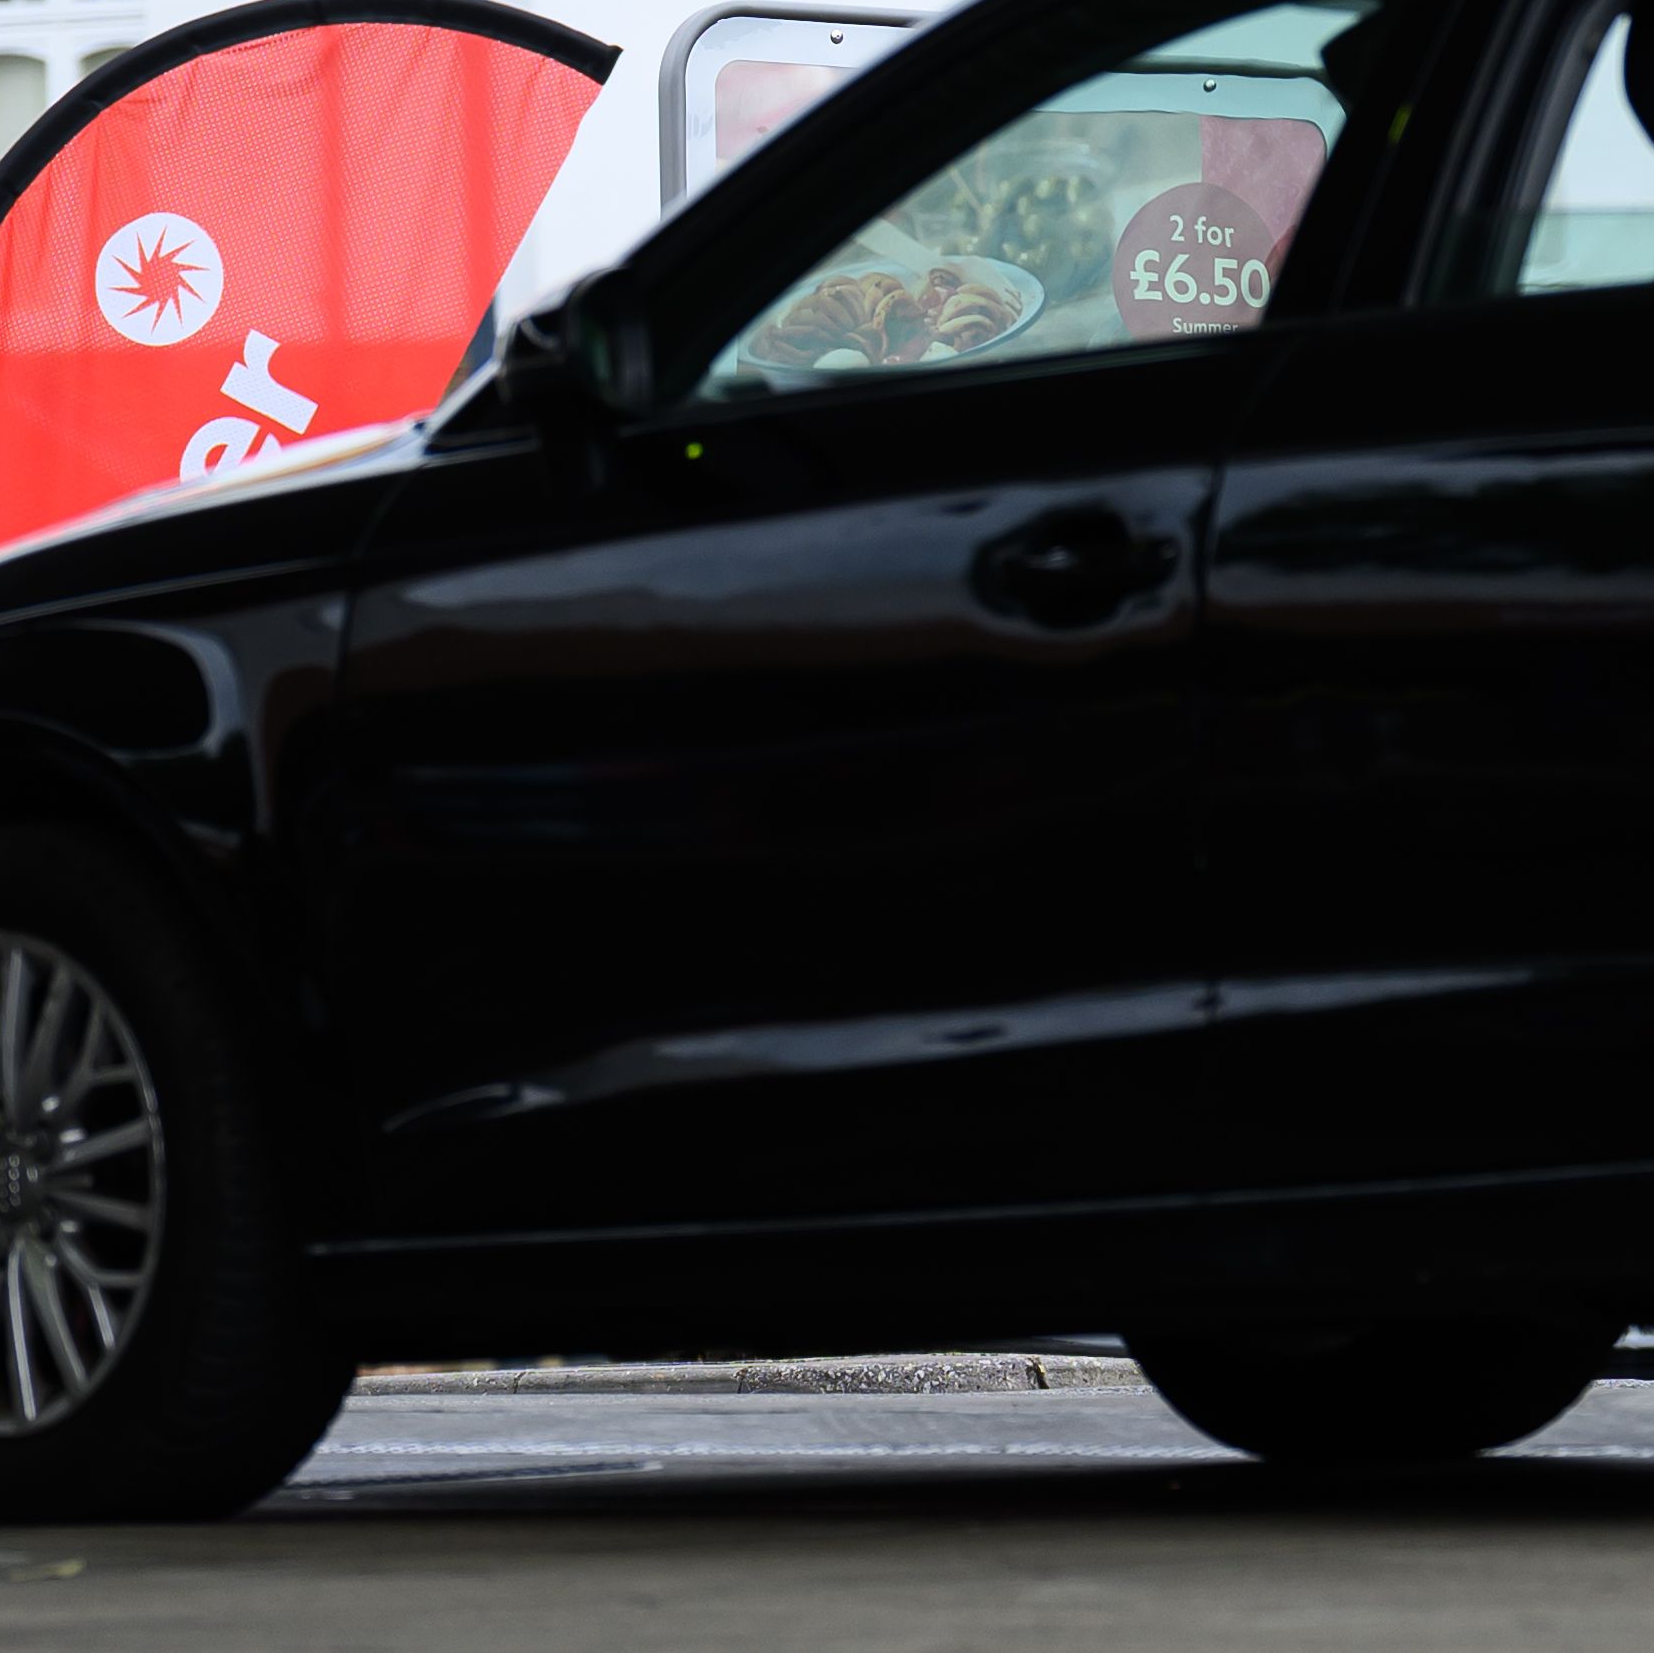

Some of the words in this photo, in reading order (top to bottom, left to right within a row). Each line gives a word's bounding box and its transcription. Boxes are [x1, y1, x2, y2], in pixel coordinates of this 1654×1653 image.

[1169, 215, 1186, 242] 2
[1194, 216, 1234, 248] for
[1130, 249, 1272, 308] £6.50
[1172, 317, 1239, 335] Summer
